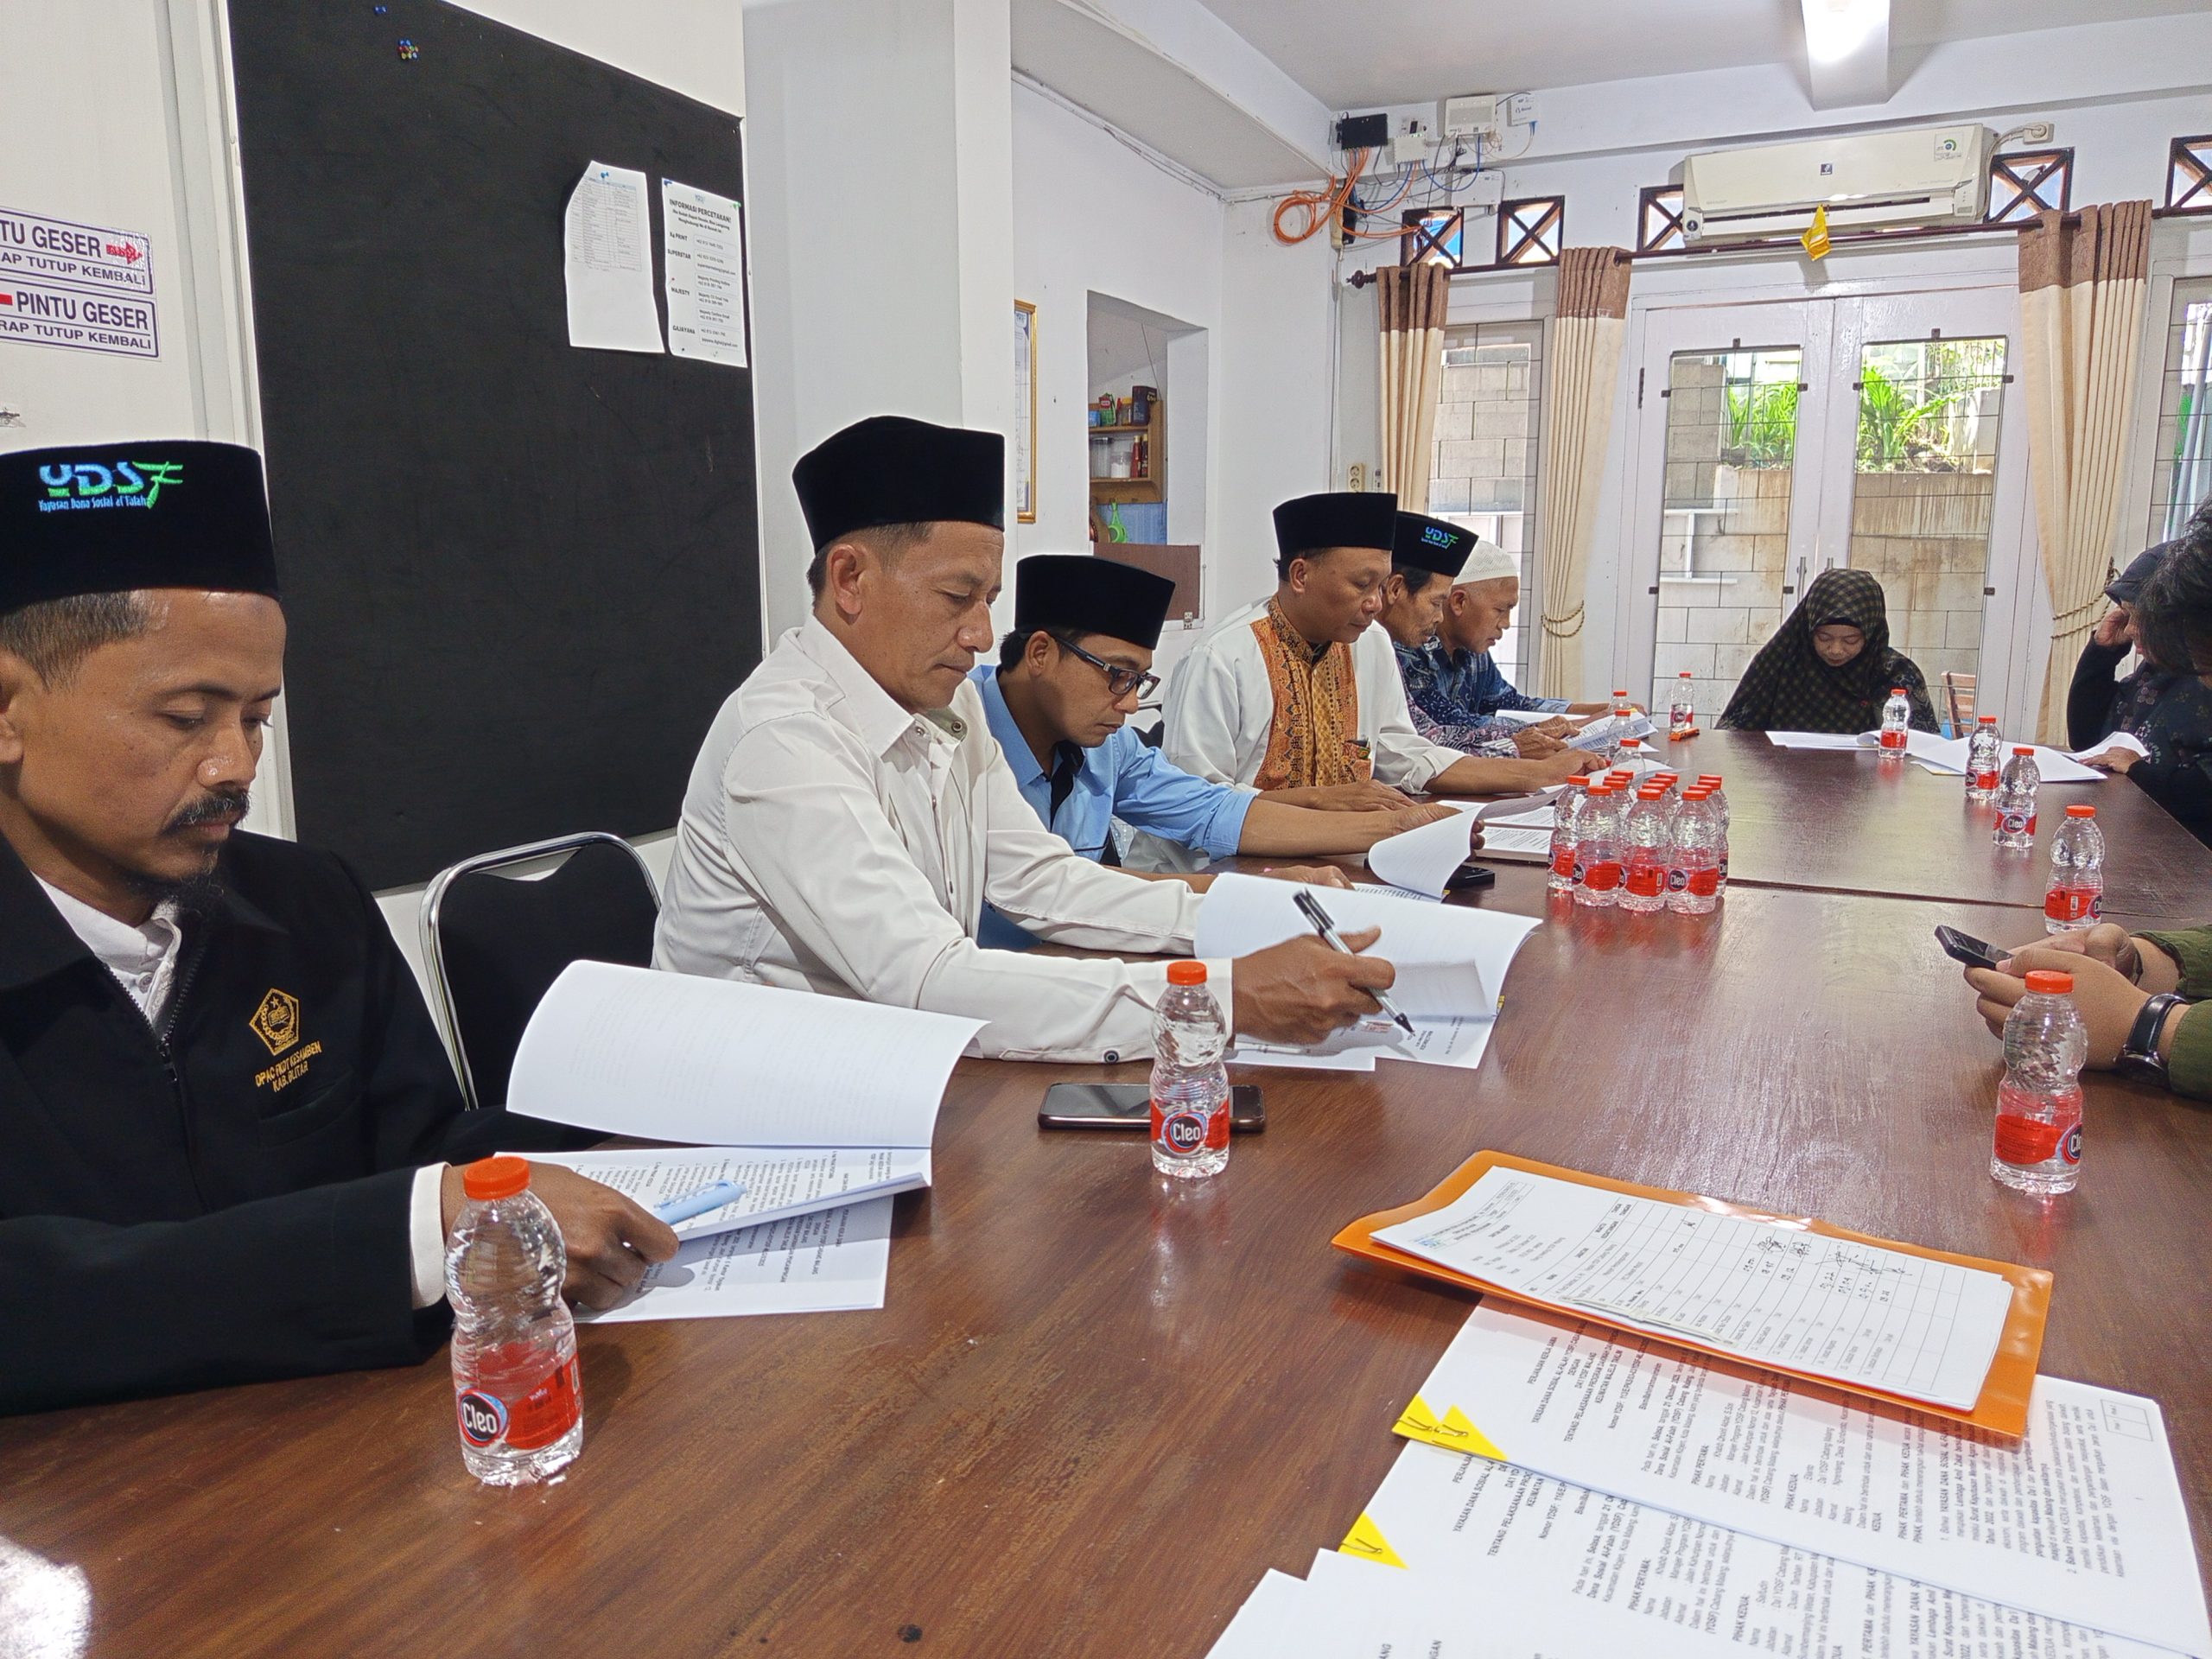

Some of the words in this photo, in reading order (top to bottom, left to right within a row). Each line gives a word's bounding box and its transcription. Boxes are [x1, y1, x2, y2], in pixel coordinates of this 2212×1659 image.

[670, 199, 696, 212] INFORMASI
[32, 226, 102, 258] GESER
[668, 249, 691, 259] SUPERSTAR
[26, 256, 77, 274] TUTUP
[82, 265, 146, 286] KEMBALI
[671, 286, 690, 296] MAJESTY
[16, 291, 76, 320] PINTU
[83, 302, 149, 330] GESER
[34, 324, 83, 340] TUTUP
[89, 332, 151, 349] KEMBALI
[1670, 875, 1686, 887] Cleo
[1173, 1123, 1200, 1141] Cleo
[462, 1402, 498, 1434] Cleo
[1452, 1454, 1472, 1482] PERJANJIA
[1453, 1507, 1471, 1532] YAYASAN
[1466, 1491, 1478, 1507] DANA
[1474, 1472, 1489, 1491] SOSIAL
[1526, 1478, 1544, 1506] KEUMATAN
[1502, 1487, 1525, 1527] PELAKSANAAN
[1539, 1520, 1552, 1539] Nomor
[1629, 1591, 1640, 1610] PIHAK
[1733, 1620, 1744, 1642] PIHAK
